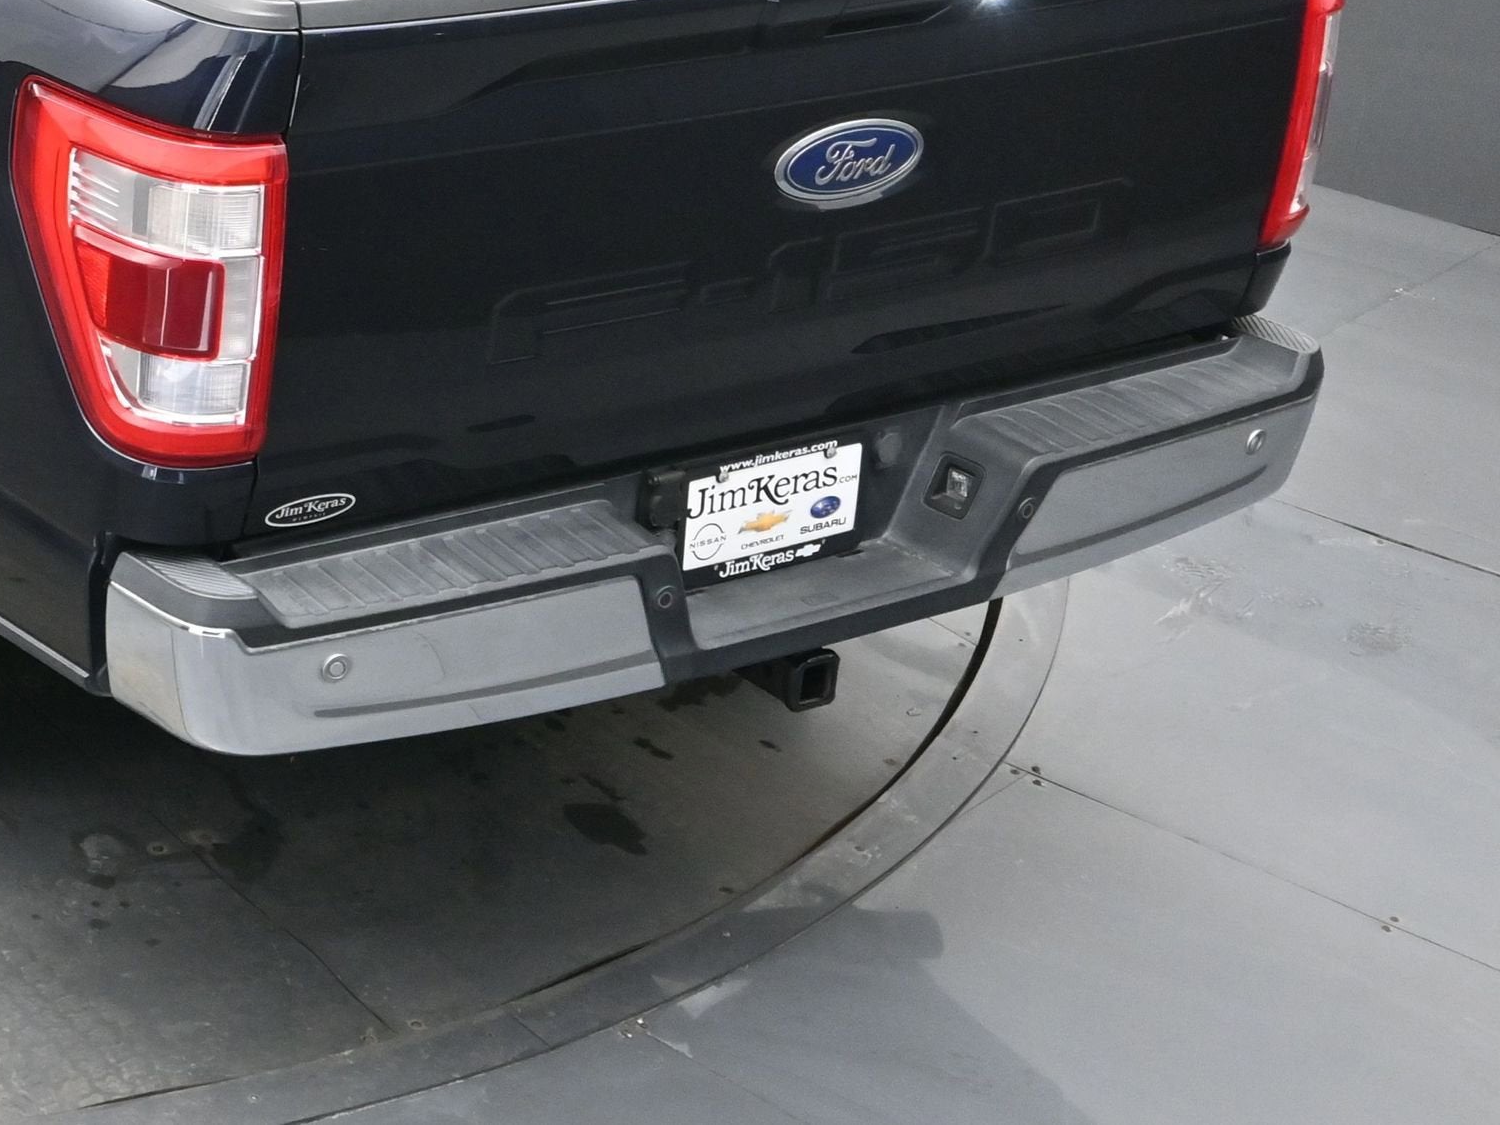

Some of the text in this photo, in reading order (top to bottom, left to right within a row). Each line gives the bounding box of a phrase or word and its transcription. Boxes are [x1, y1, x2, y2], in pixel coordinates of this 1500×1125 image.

[814, 137, 896, 186] Ford
[719, 439, 838, 473] www.jimkeras.com
[799, 516, 847, 535] SUBARU
[689, 534, 727, 550] NISSAN
[740, 534, 785, 551] CHEVROLET
